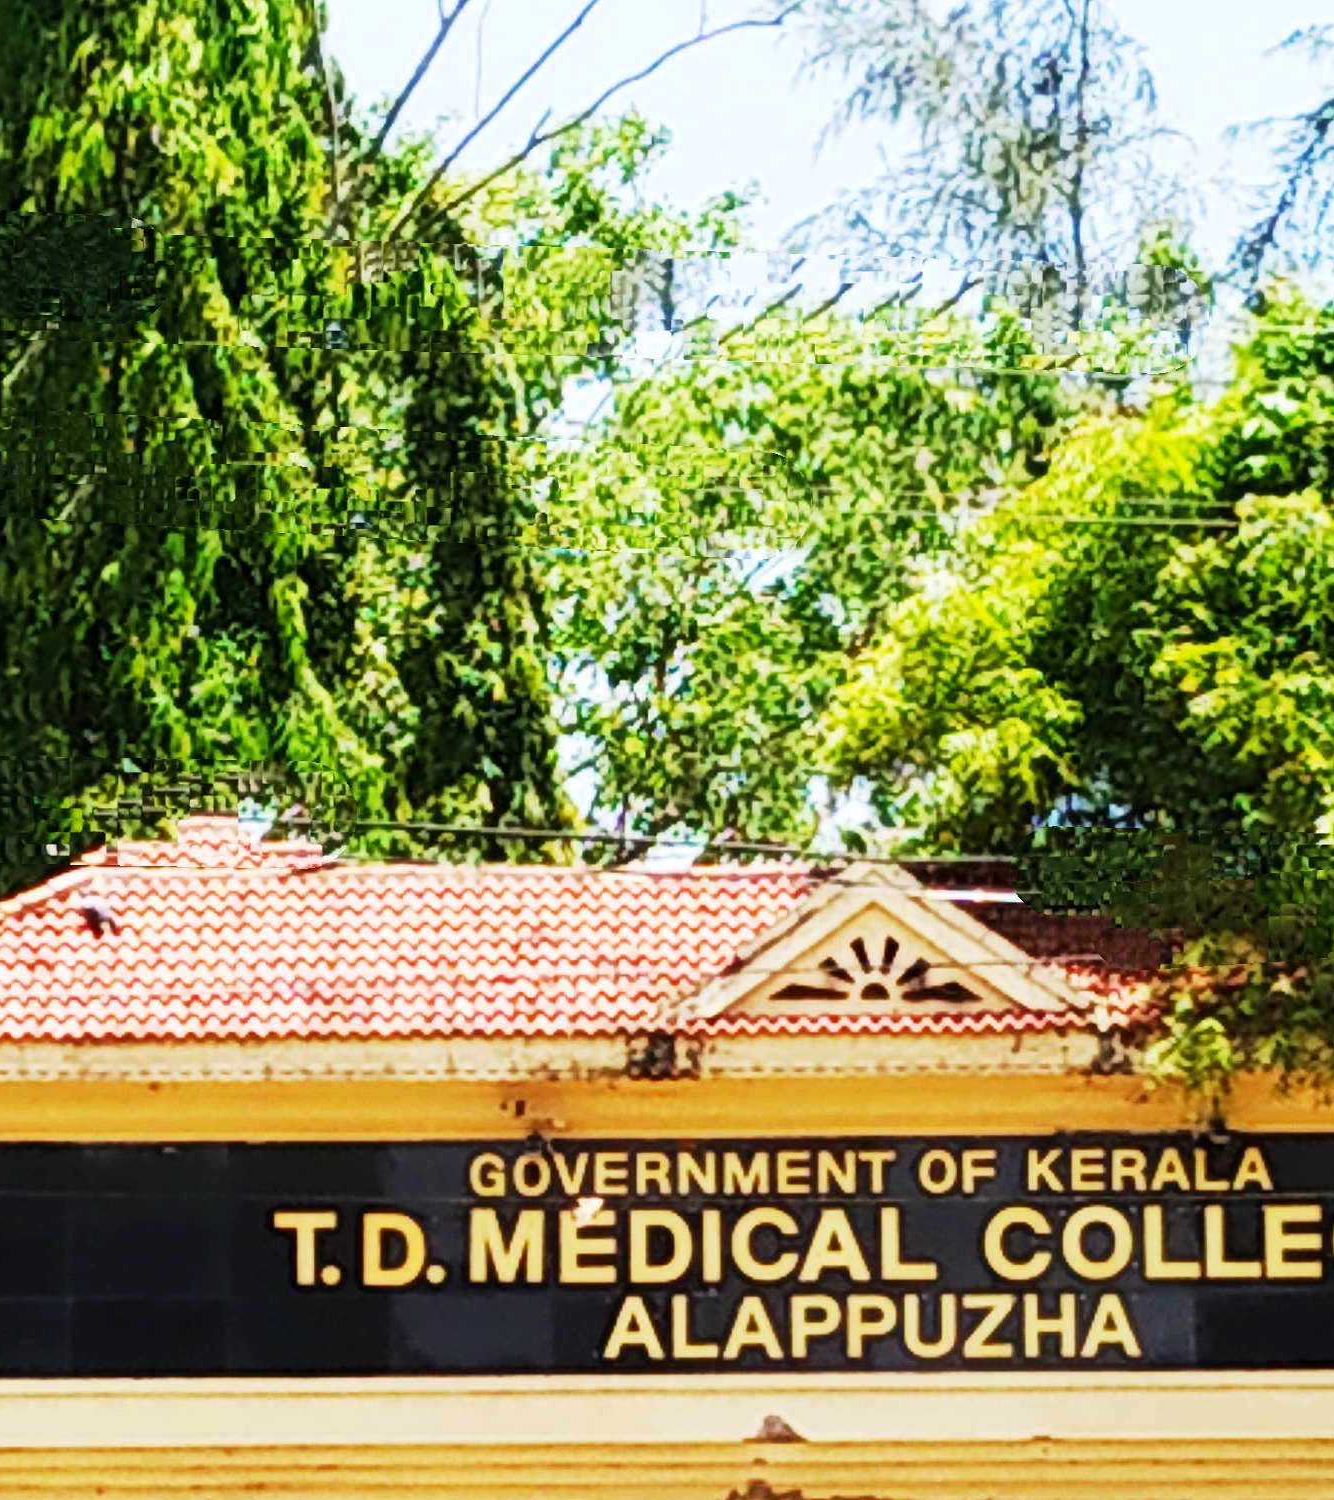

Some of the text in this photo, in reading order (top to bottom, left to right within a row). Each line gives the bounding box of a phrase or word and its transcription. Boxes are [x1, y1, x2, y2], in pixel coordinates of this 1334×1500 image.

[469, 1147, 1273, 1198] GOVERNMENT OF KERALA
[468, 1205, 937, 1284] MEDICAL
[603, 1293, 1142, 1360] ALAPPUZHA
